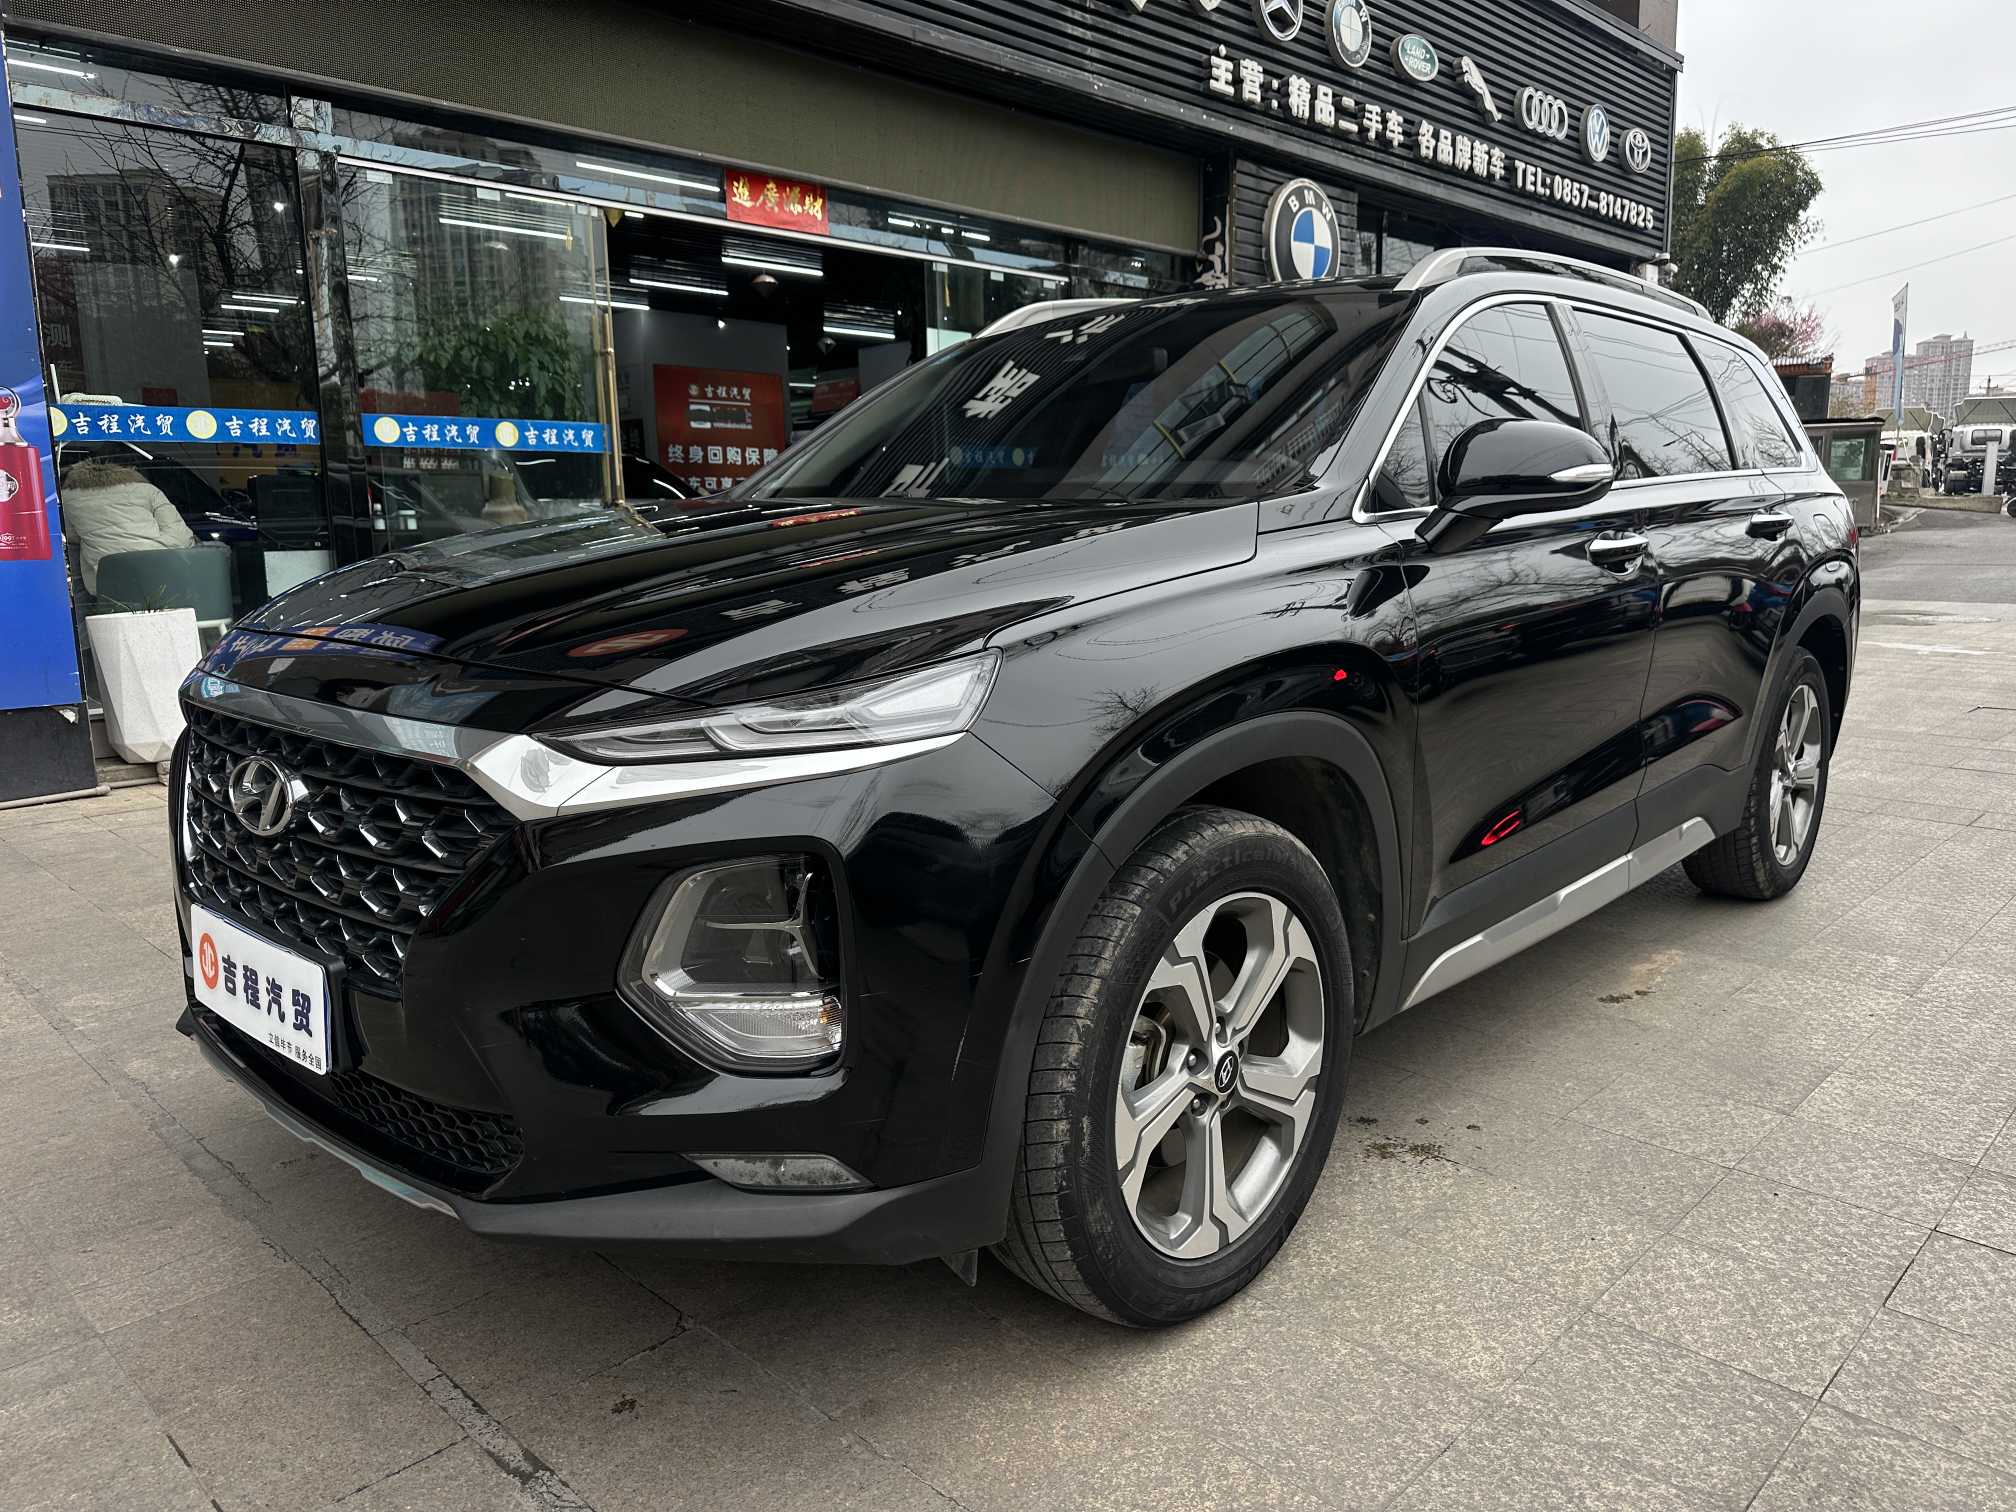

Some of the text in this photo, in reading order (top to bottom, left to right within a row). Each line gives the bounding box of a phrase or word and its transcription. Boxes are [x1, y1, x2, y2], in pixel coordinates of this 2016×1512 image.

[1418, 119, 1505, 181] 各品牌新车
[1287, 188, 1331, 221] BMW
[71, 411, 316, 440] 吉程汽贸 吉程汽贸
[402, 422, 594, 448] 吉程汽贸 吉程汽贸
[222, 954, 312, 1038] 吉程汽贸
